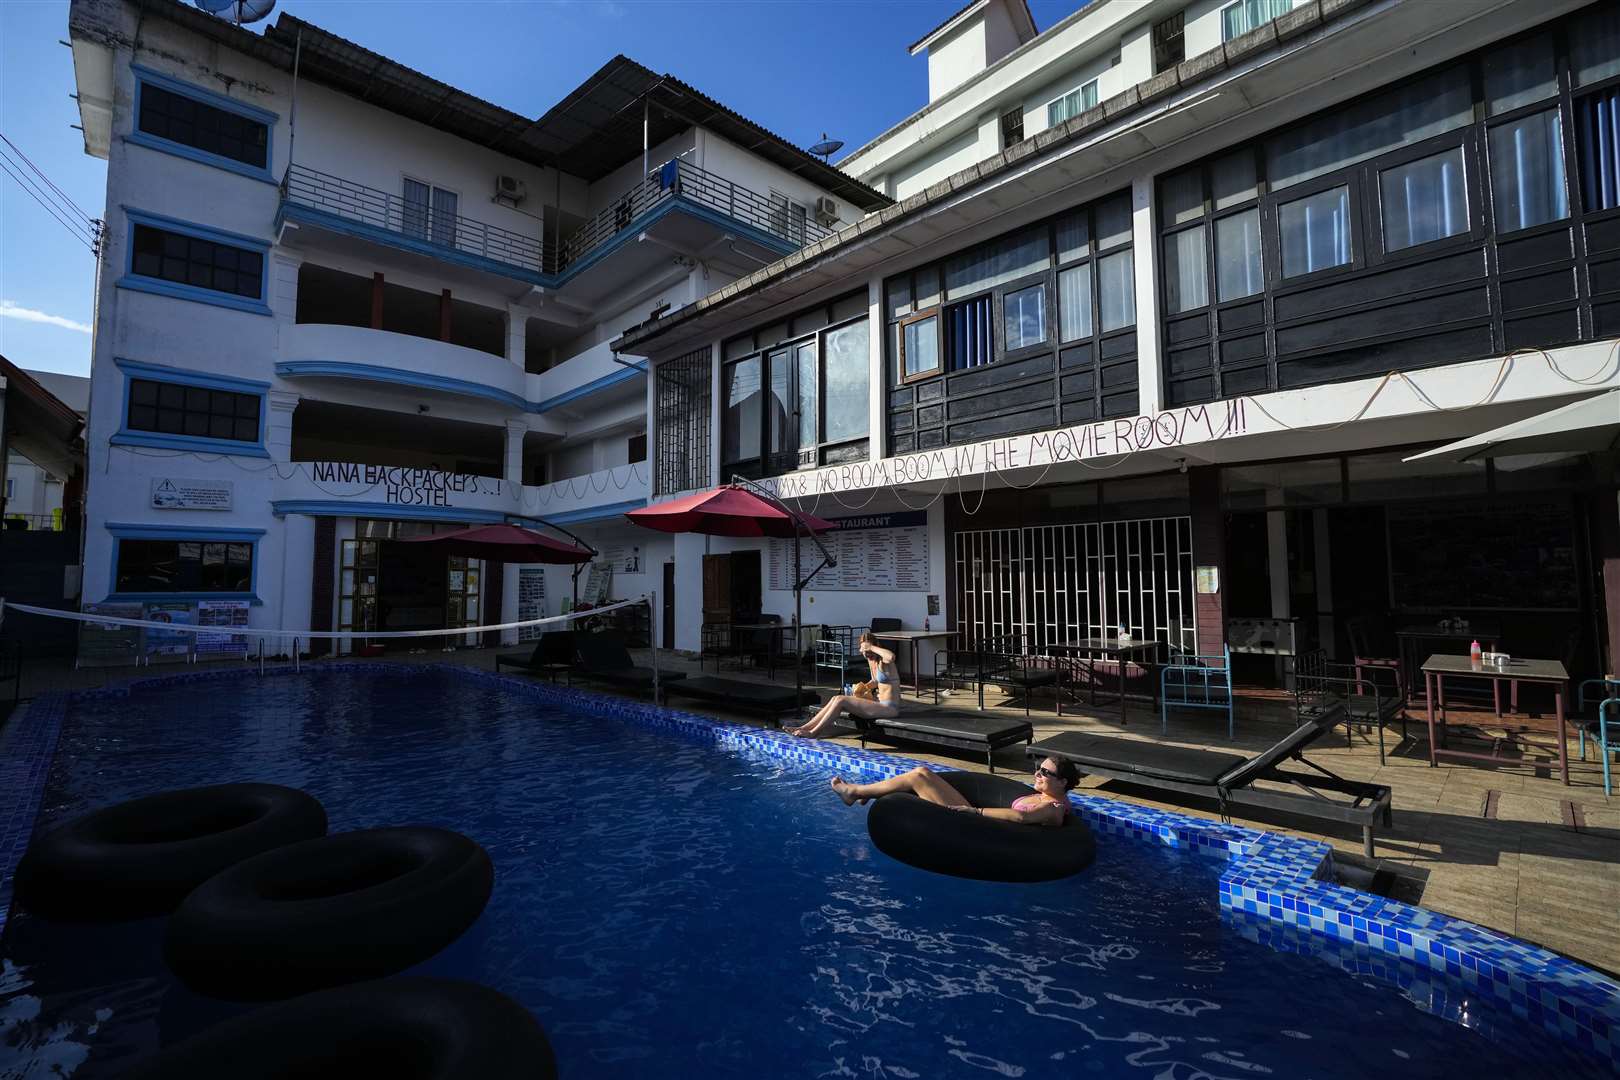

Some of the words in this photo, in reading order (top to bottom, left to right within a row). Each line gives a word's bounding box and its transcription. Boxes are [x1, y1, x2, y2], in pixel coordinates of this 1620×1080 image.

[799, 475, 808, 494] &
[816, 469, 838, 493] NO
[842, 462, 887, 490] BOOM
[894, 451, 950, 483] BOOM
[954, 445, 977, 475] IN
[980, 439, 1019, 471] THE
[1029, 428, 1108, 466] MOVIE
[1115, 405, 1214, 454] ROOM
[313, 461, 361, 484] NANA
[386, 484, 453, 507] HOSTEL
[834, 516, 891, 529] STAURANT
